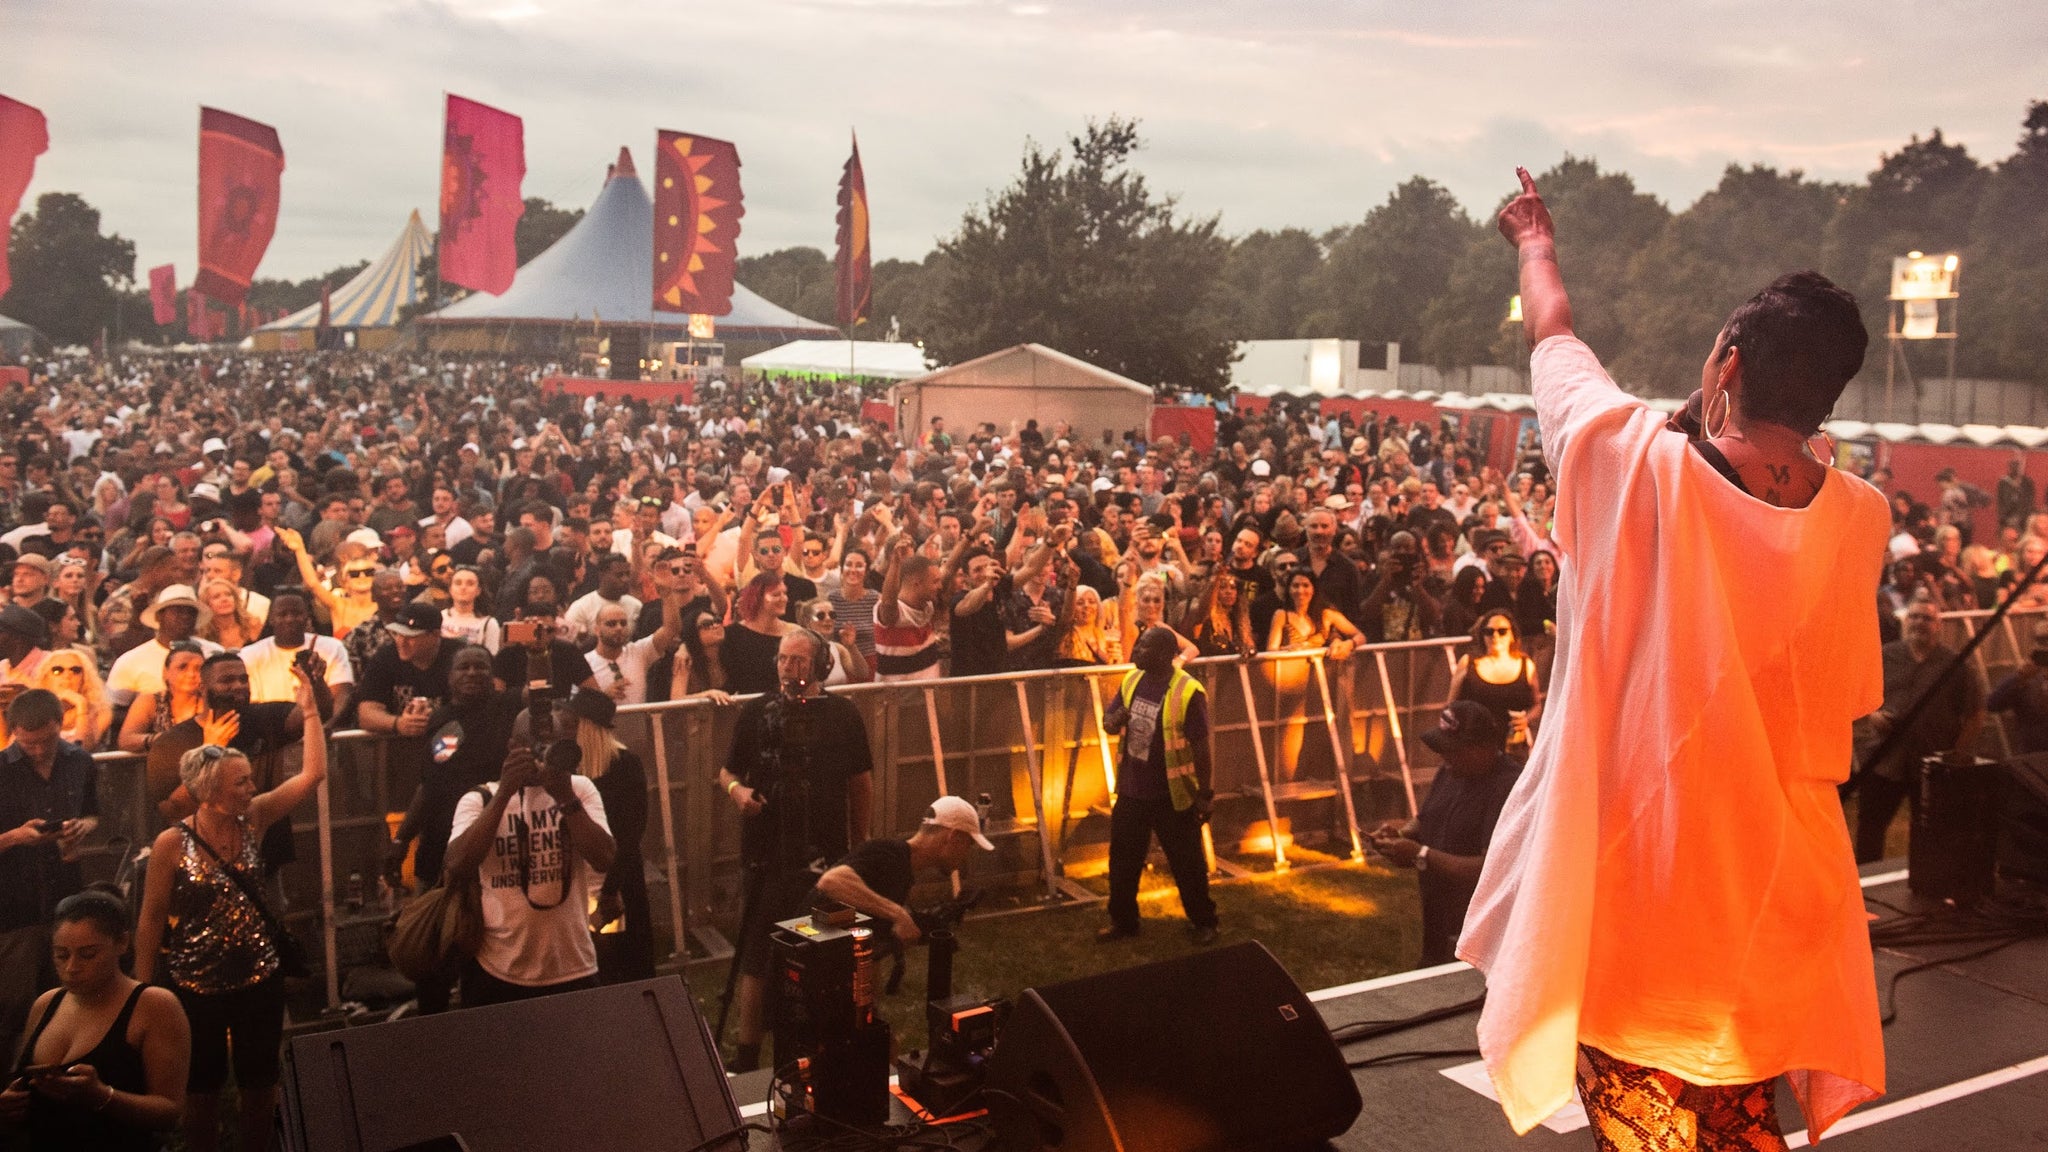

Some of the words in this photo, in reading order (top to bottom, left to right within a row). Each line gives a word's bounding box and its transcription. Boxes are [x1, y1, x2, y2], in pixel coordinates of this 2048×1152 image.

[508, 812, 526, 832] IN
[532, 807, 559, 828] MY
[510, 855, 537, 870] WS
